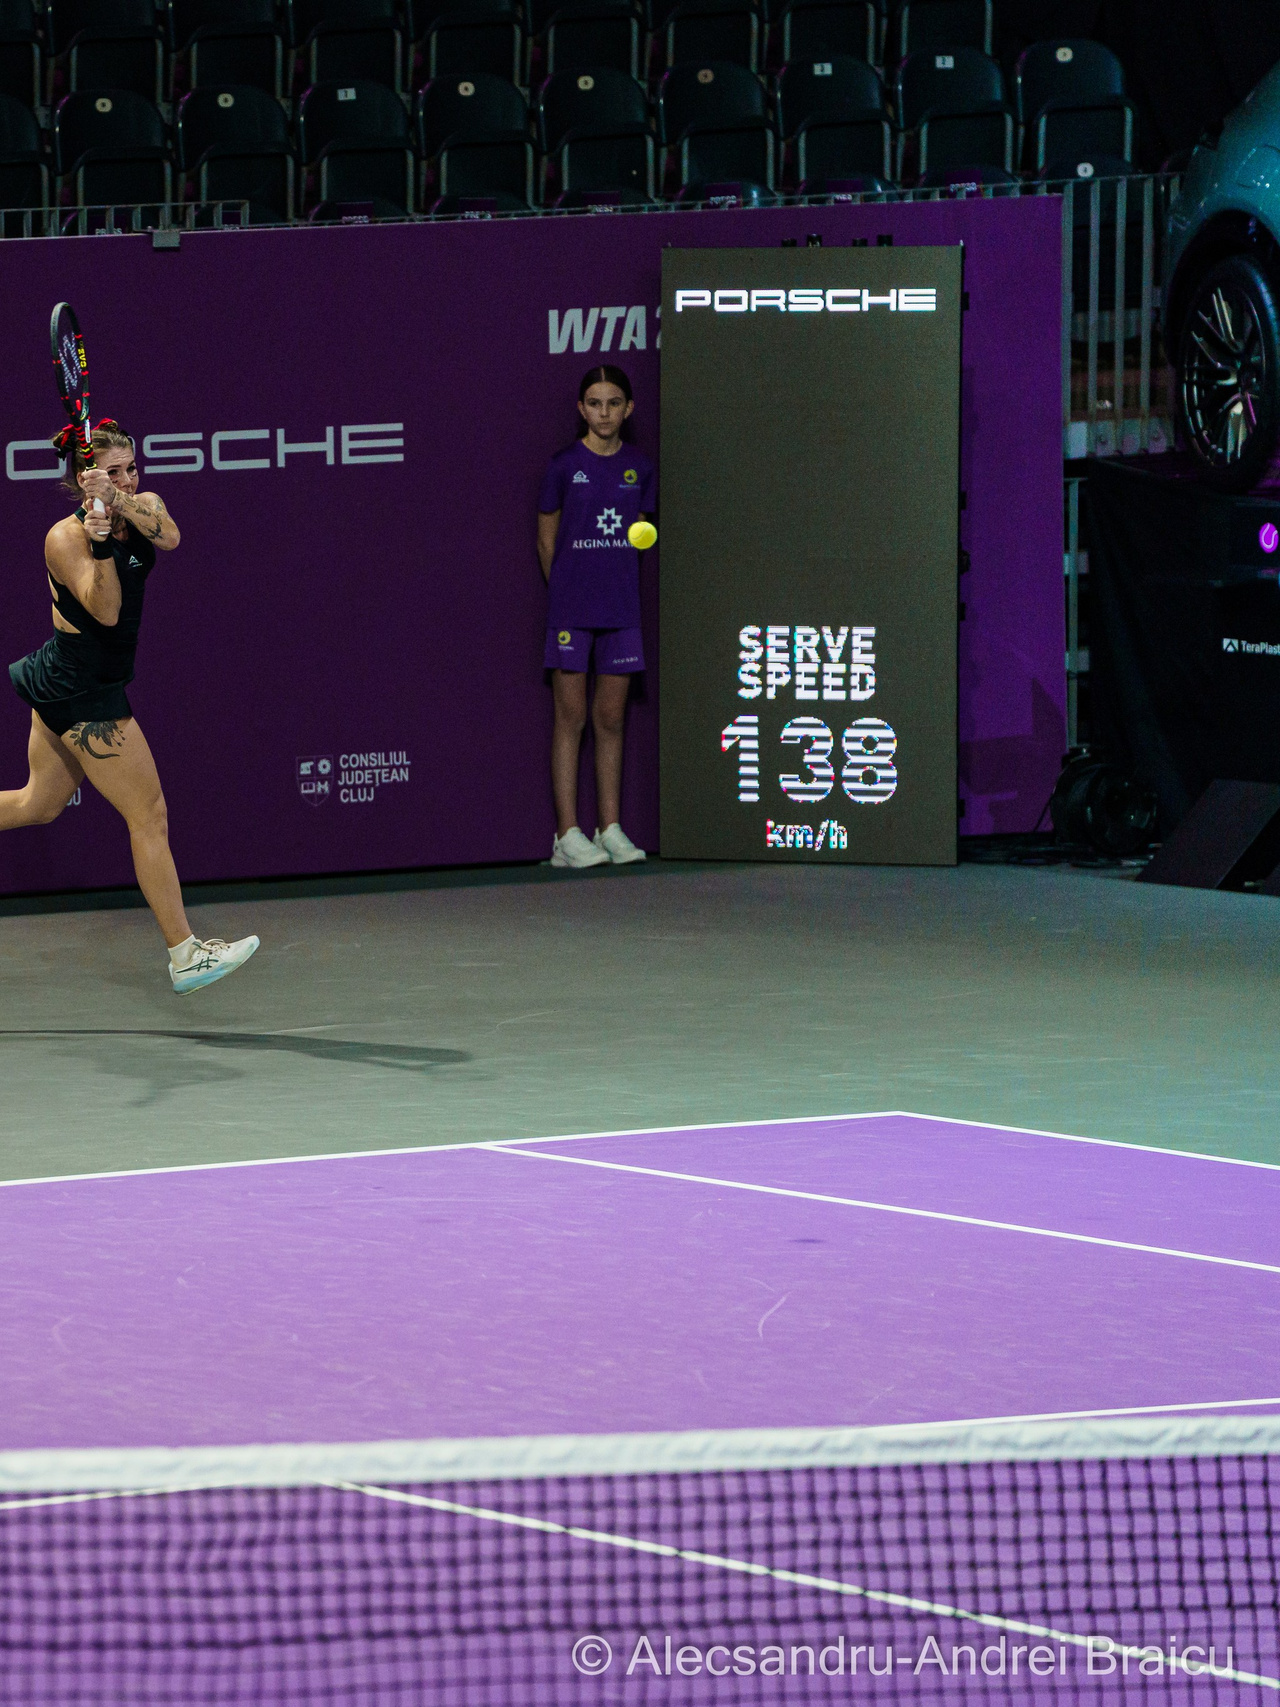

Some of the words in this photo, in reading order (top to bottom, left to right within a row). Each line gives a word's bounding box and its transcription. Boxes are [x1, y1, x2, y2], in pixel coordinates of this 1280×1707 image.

[675, 288, 937, 313] PORSCHE
[549, 306, 647, 354] WTA
[573, 538, 610, 549] REGINA
[739, 625, 876, 663] SERVE
[737, 662, 876, 700] SPEED
[339, 751, 411, 769] CONSILIUL
[721, 714, 898, 805] 138
[339, 786, 375, 804] CLUJ
[766, 818, 848, 851] km/h
